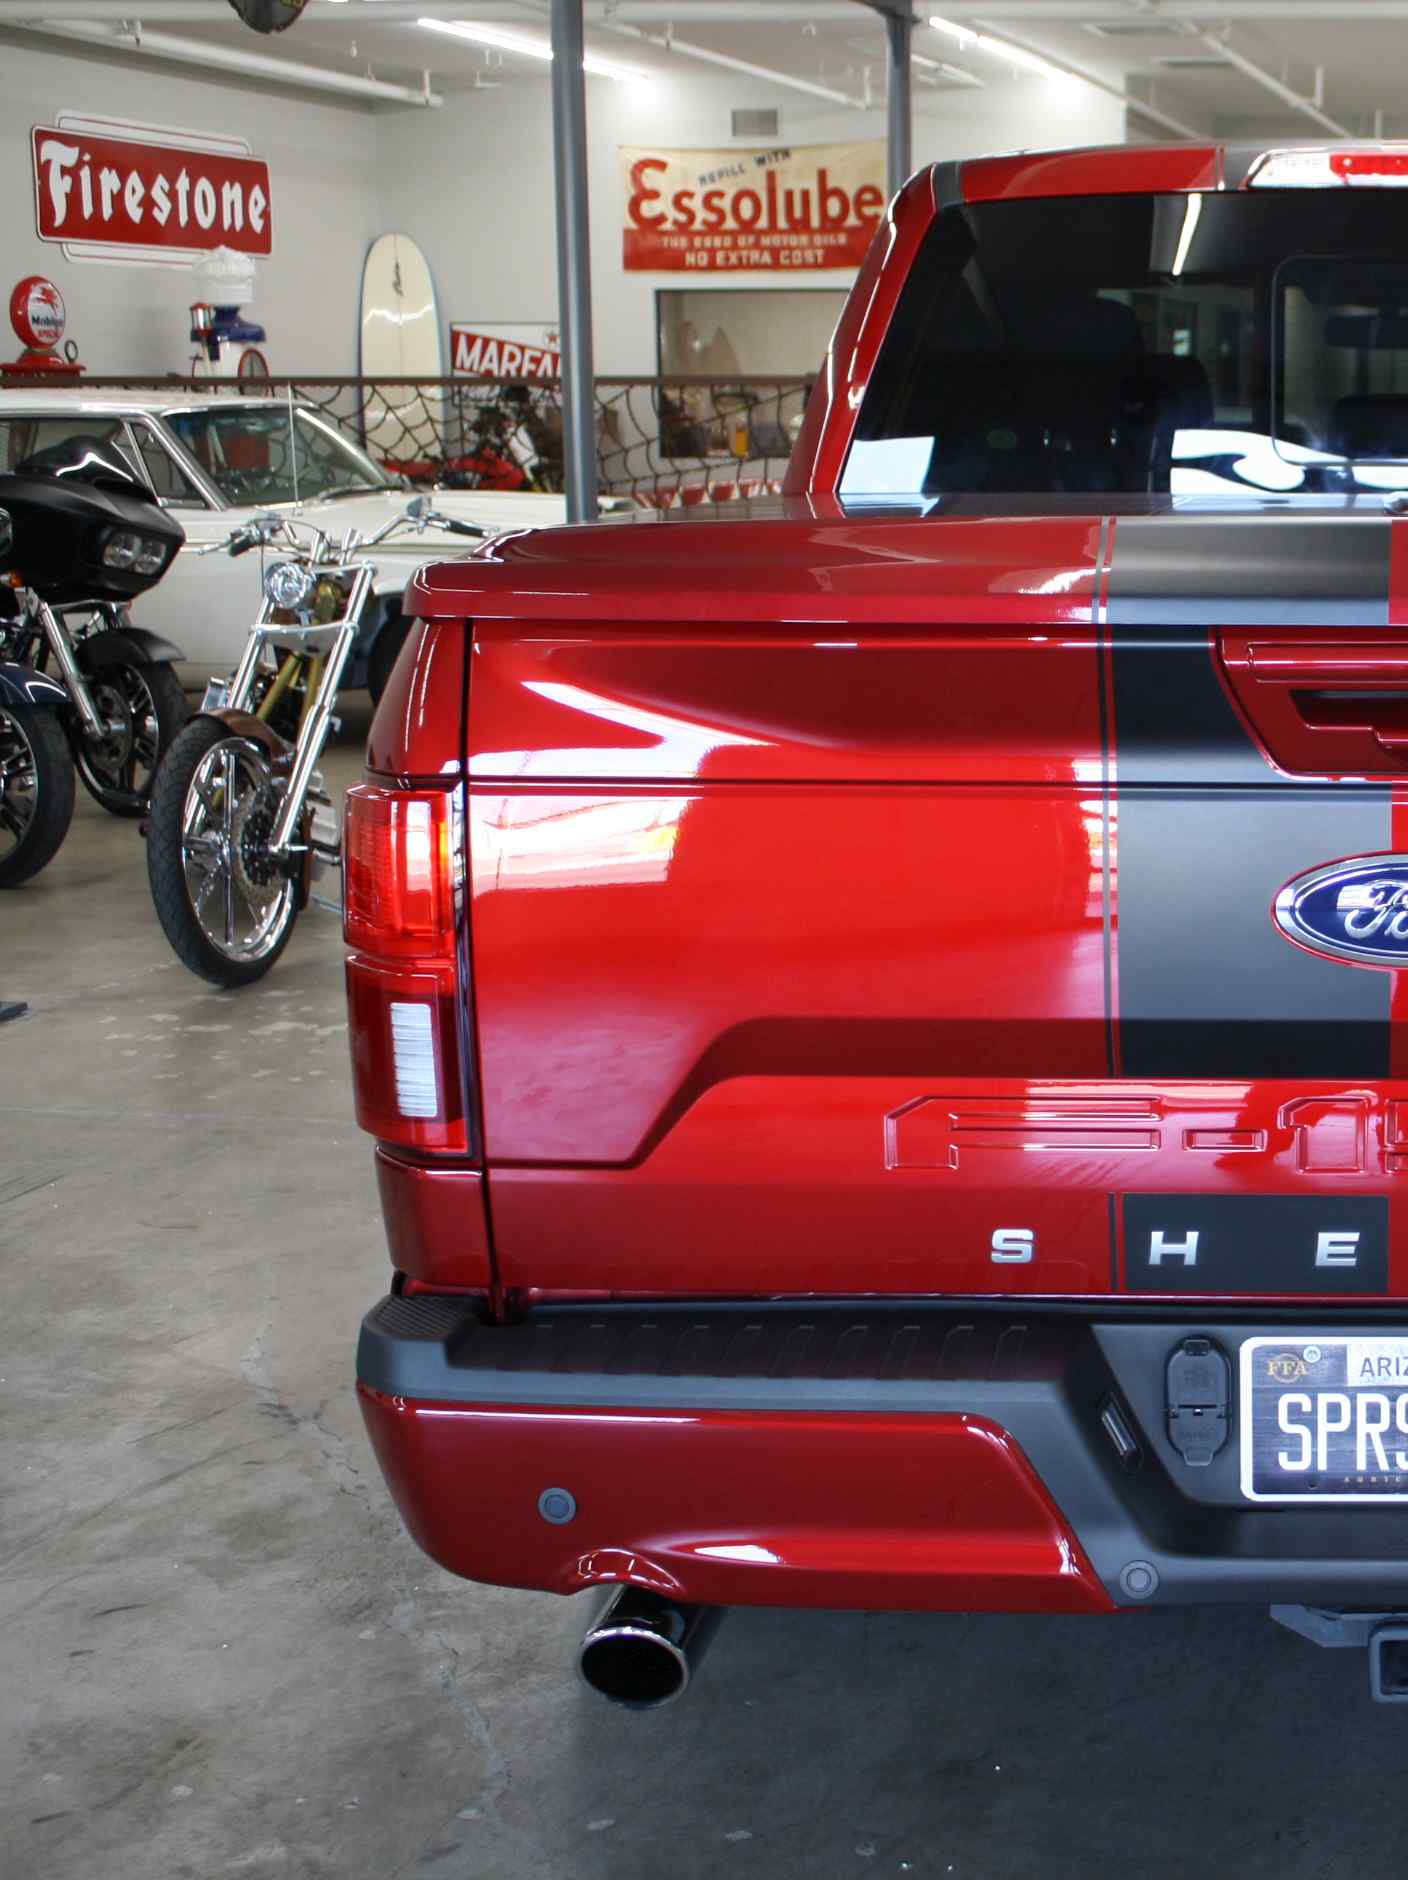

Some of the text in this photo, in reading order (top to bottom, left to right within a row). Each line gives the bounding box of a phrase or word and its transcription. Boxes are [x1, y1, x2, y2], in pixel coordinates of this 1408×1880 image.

[697, 149, 791, 186] REFILL WITH
[40, 139, 266, 234] Firestone
[628, 158, 885, 231] Essolube
[684, 249, 825, 267] NO EXTRA COST
[737, 235, 755, 247] OF
[455, 333, 560, 378] MARFA
[1266, 1359, 1310, 1376] FFA
